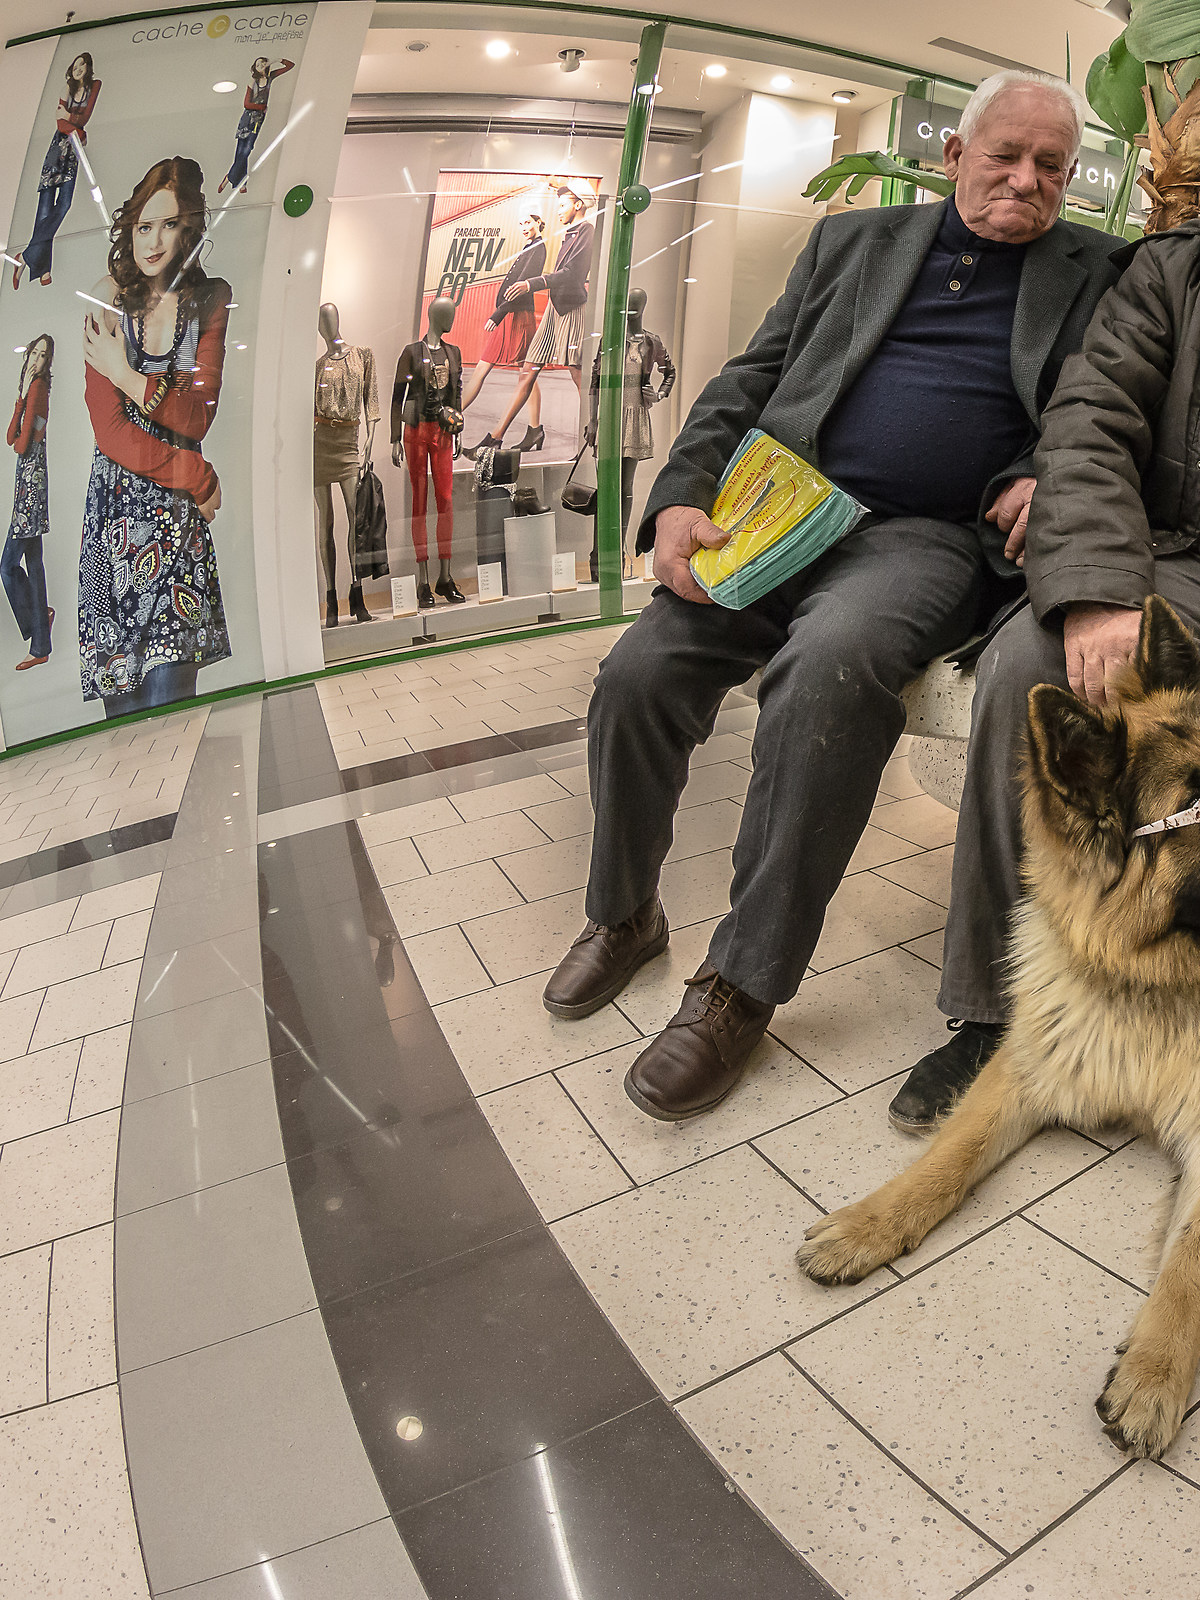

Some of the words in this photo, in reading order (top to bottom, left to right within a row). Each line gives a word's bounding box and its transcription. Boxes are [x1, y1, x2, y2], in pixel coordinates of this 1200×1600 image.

[132, 20, 204, 44] cache
[234, 11, 308, 31] cache
[453, 227, 482, 238] PARADE
[482, 227, 501, 238] YOUR
[443, 237, 506, 273] NEW
